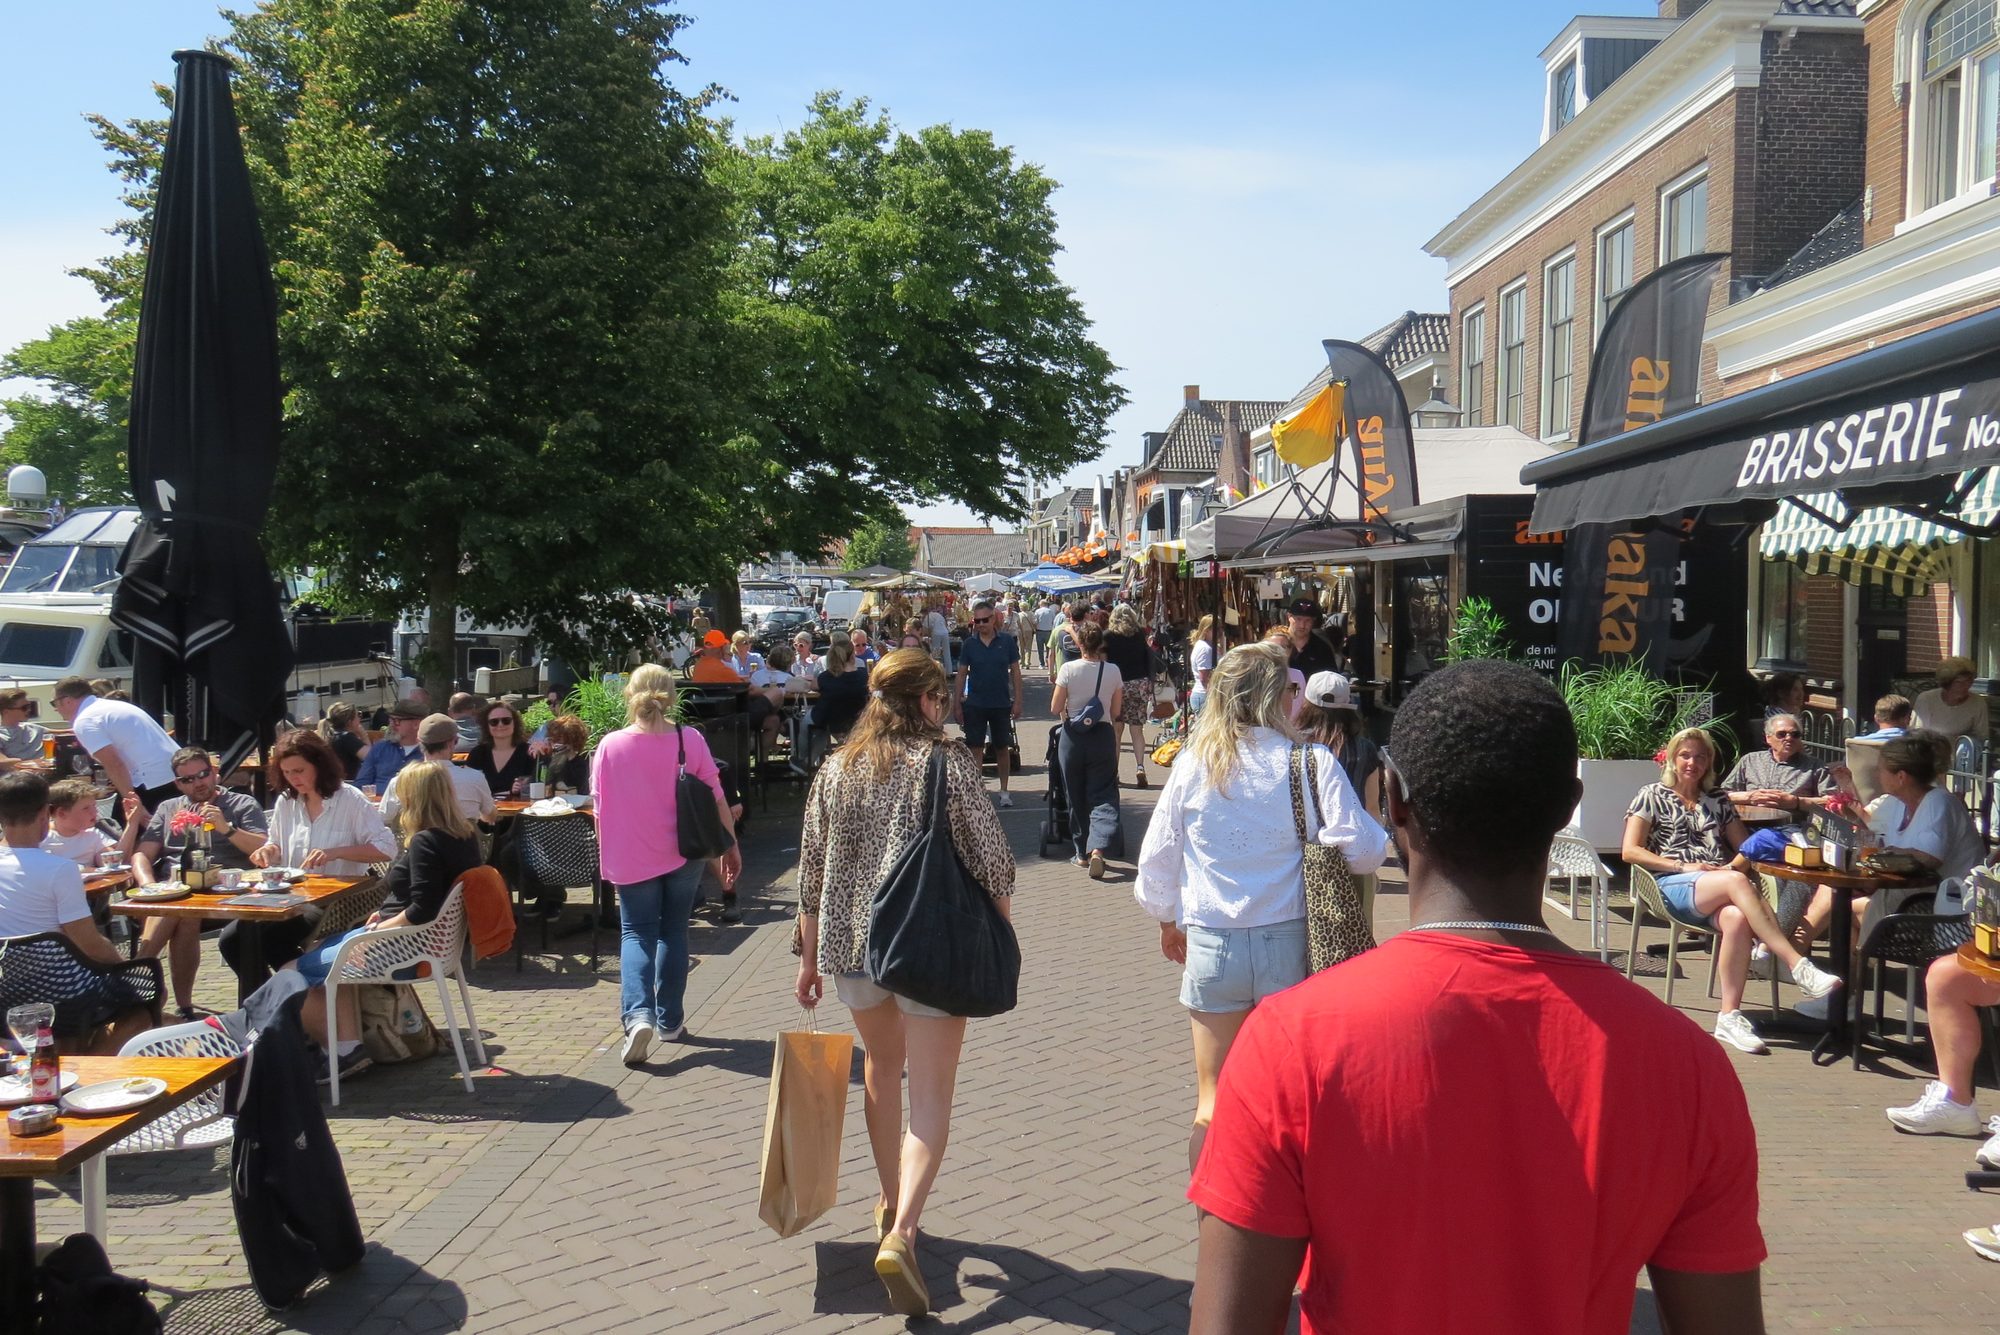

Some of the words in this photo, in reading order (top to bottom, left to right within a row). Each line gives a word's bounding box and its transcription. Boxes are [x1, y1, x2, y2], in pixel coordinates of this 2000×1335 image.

[1736, 388, 1963, 488] BRASSERIE
[1598, 532, 1649, 653] aka
[1527, 644, 1541, 655] de
